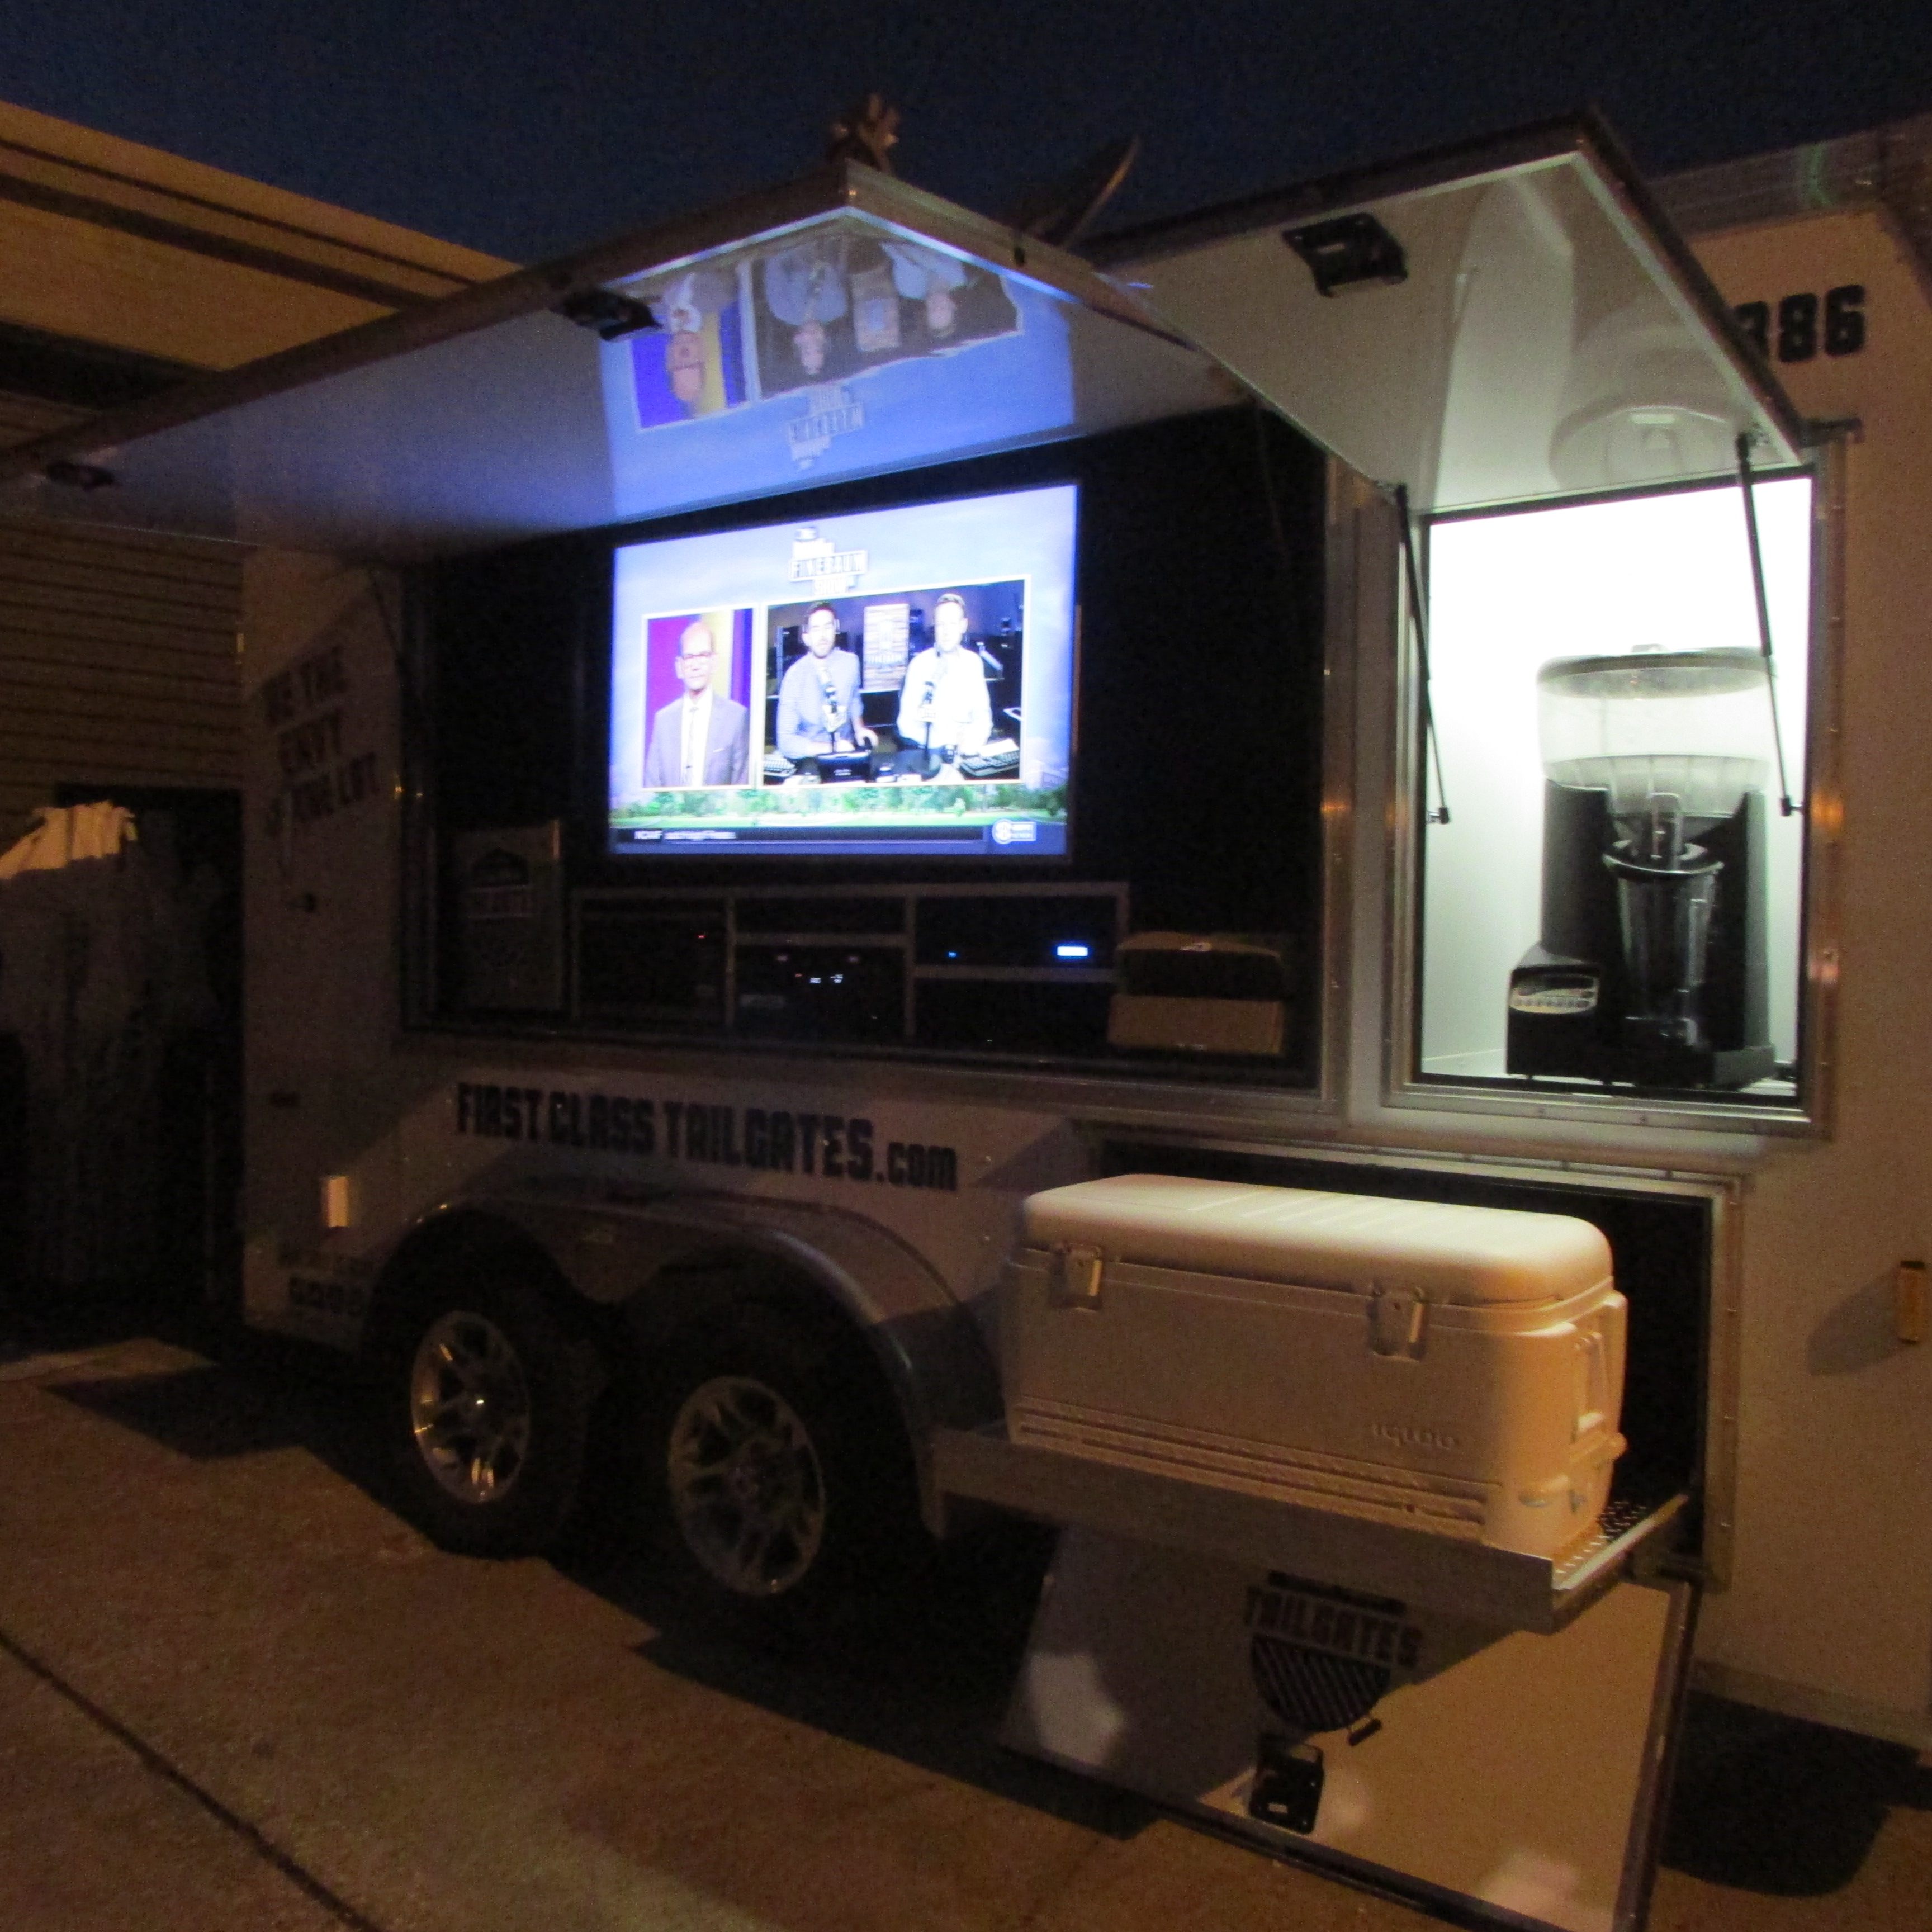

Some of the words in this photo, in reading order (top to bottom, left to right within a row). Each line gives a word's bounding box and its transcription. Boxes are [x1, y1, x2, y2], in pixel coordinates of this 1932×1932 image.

[792, 553, 865, 578] FINEBAUM
[457, 1081, 542, 1142] FIRST
[550, 1091, 655, 1156] CLASS
[1244, 1584, 1423, 1668] TAILGATES
